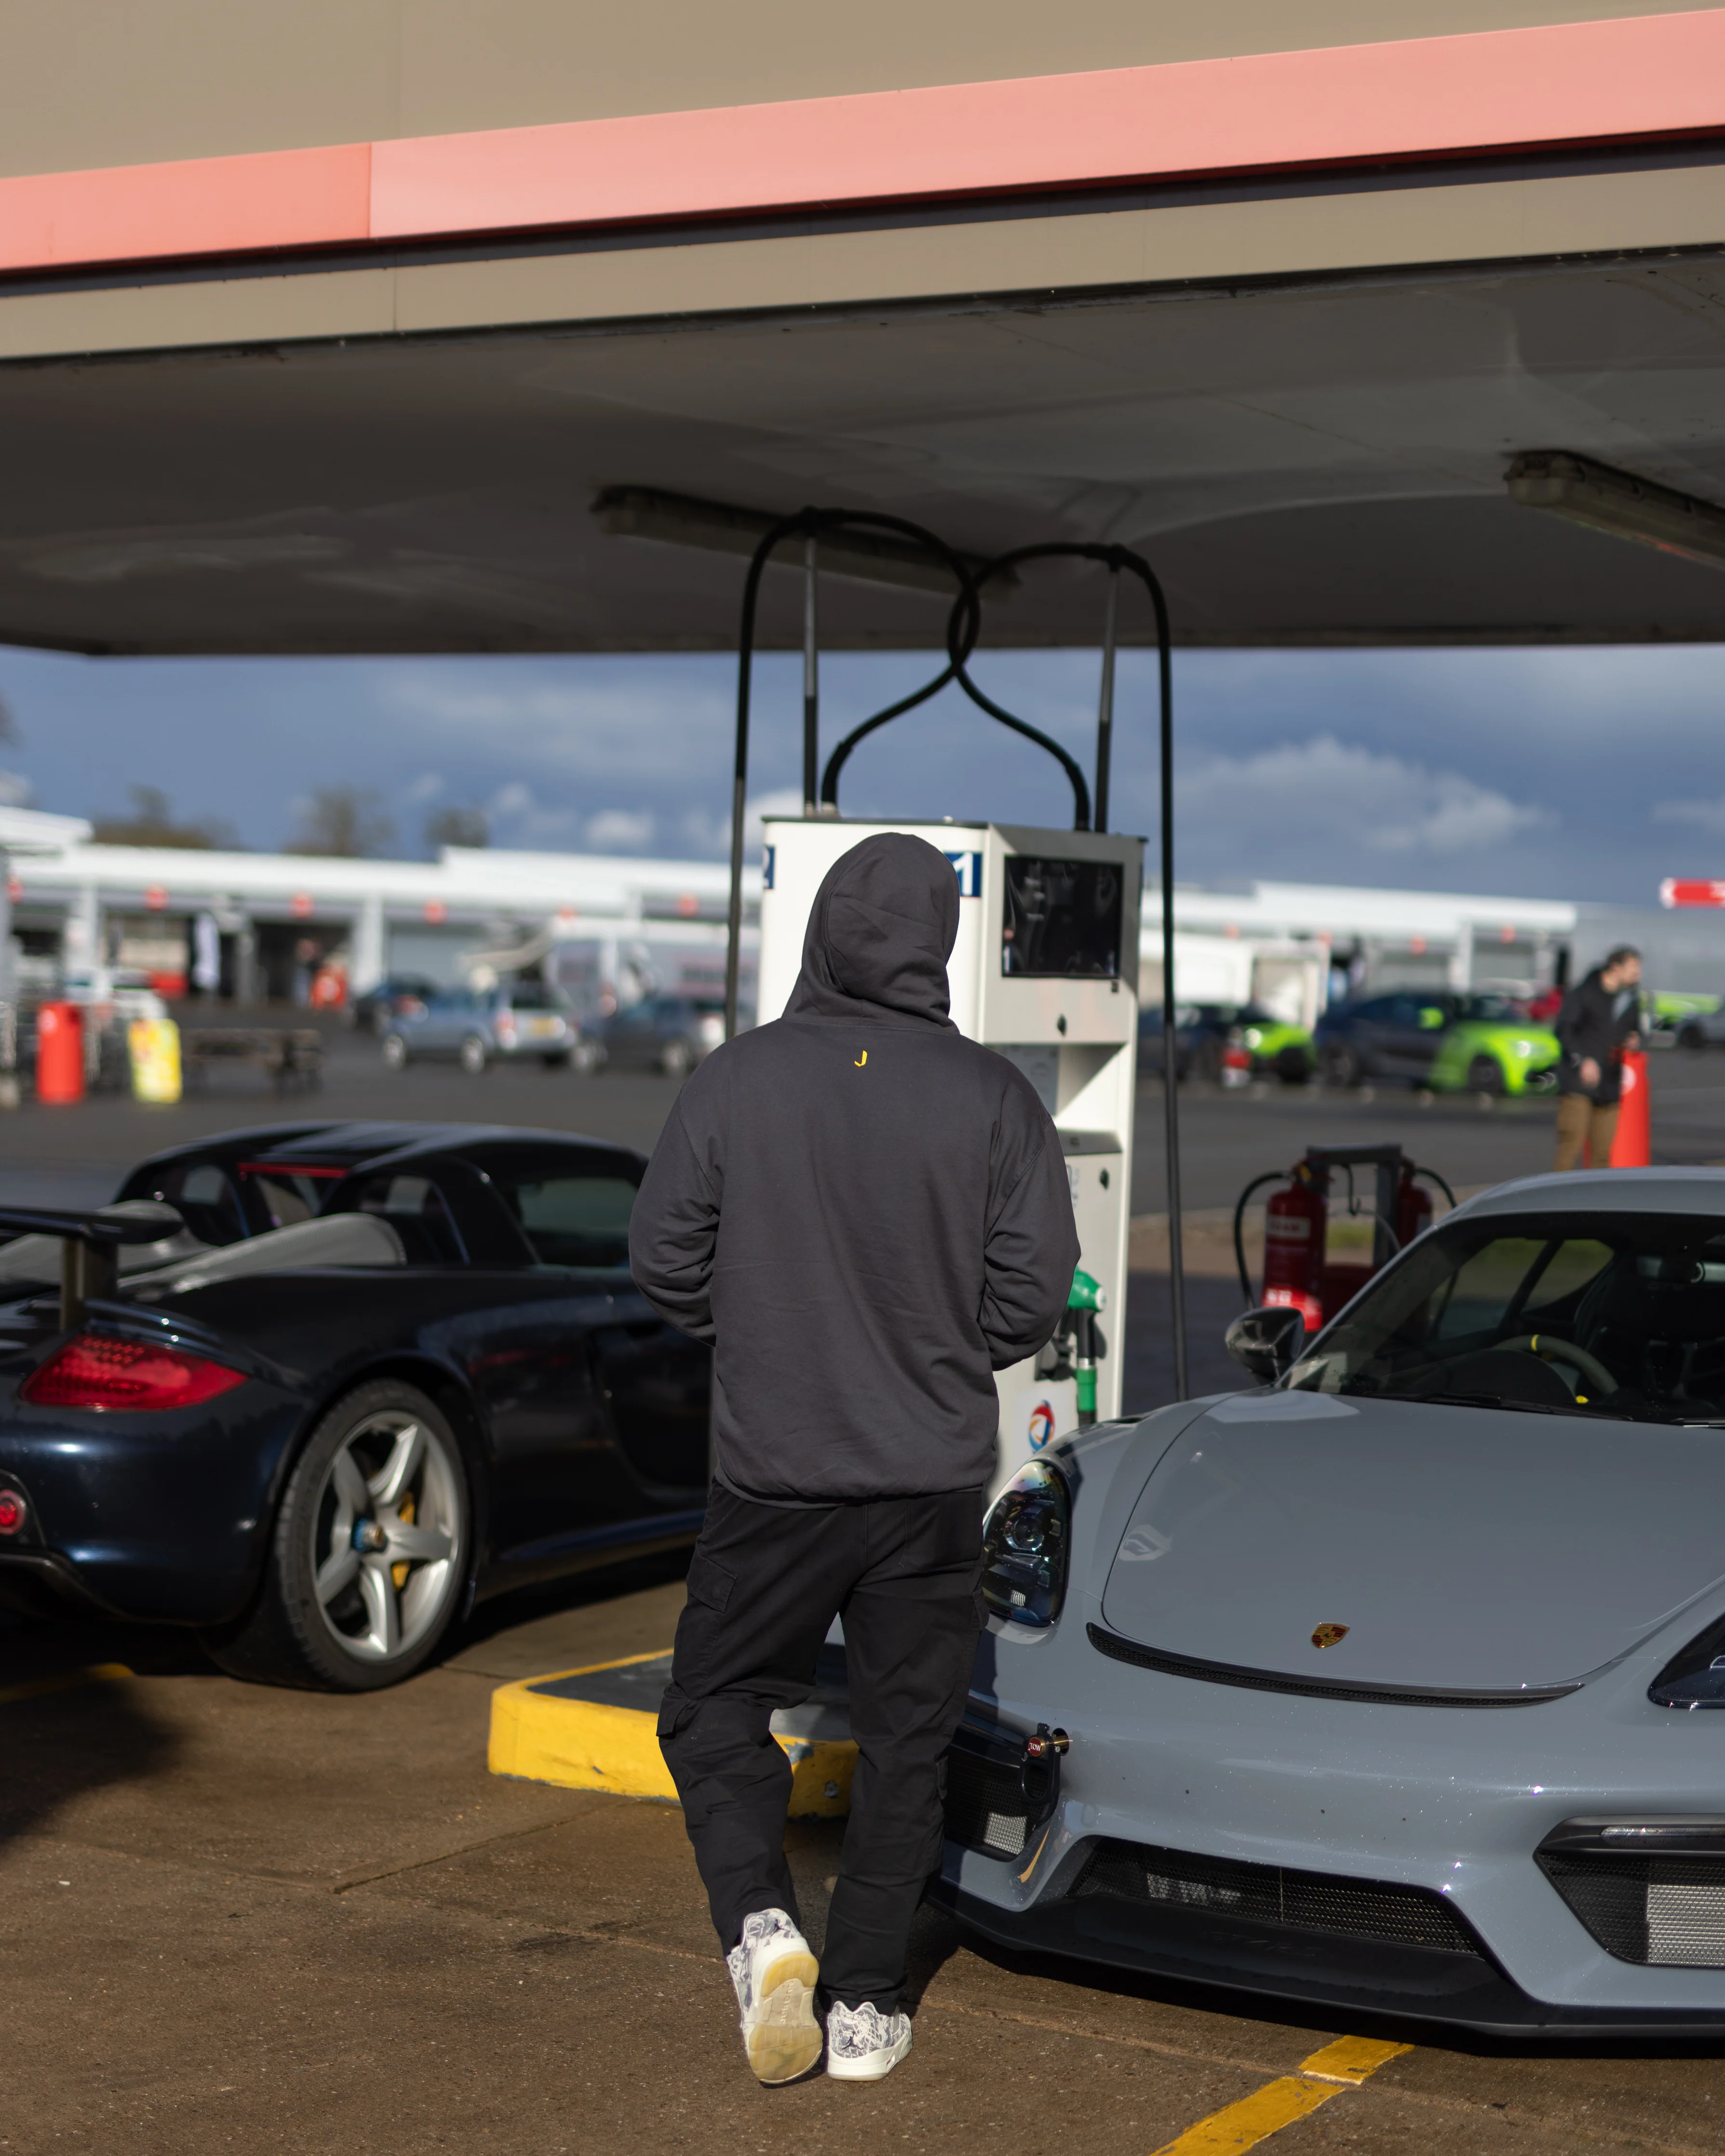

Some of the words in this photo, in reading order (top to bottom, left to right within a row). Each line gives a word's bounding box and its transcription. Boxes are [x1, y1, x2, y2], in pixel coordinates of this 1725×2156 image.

[953, 851, 973, 896] 1
[854, 1050, 867, 1066] J
[1030, 1742, 1041, 1751] TOW
